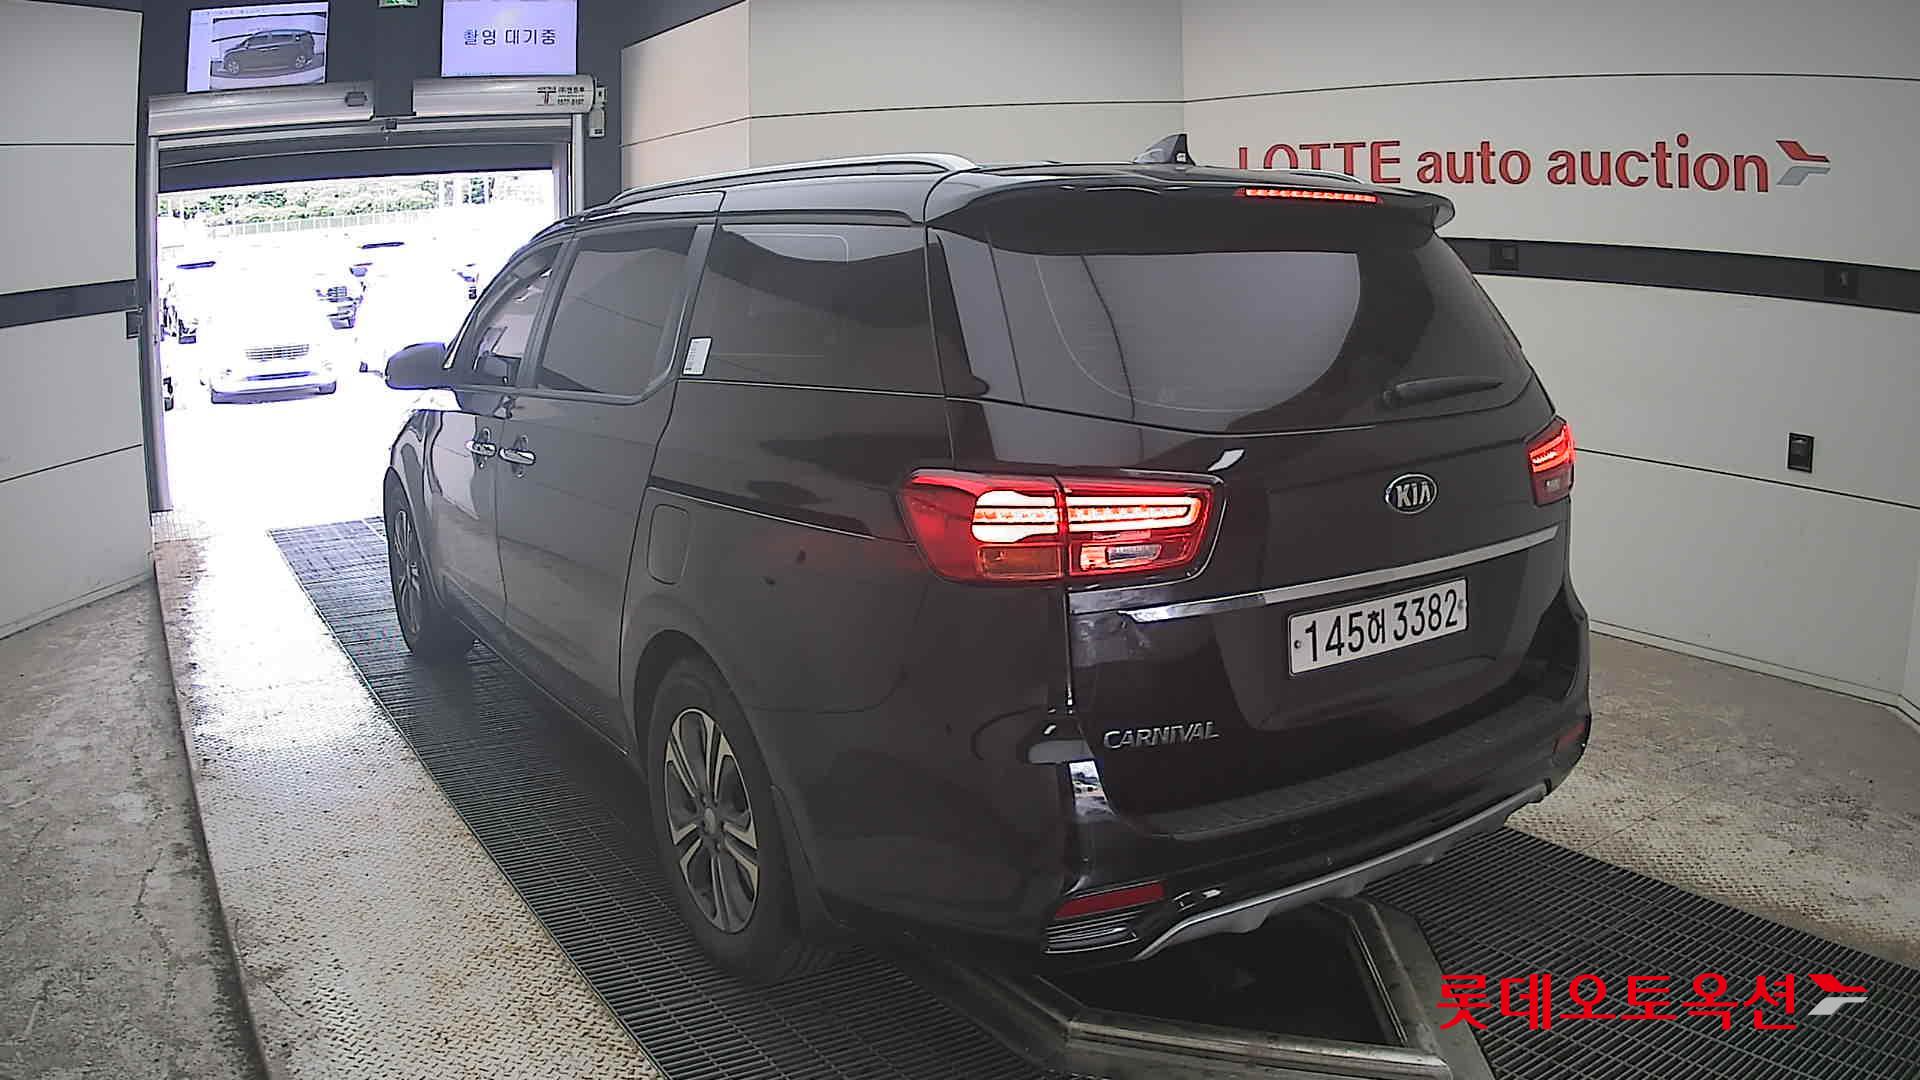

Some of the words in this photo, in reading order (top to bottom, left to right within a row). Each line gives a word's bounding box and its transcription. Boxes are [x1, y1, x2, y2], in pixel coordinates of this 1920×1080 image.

[463, 28, 497, 46] 촬영
[504, 28, 556, 46] 대기중
[1416, 140, 1532, 185] auto
[1547, 134, 1770, 192] auction
[1396, 481, 1431, 508] KIA
[1103, 721, 1220, 749] CARNIVAL
